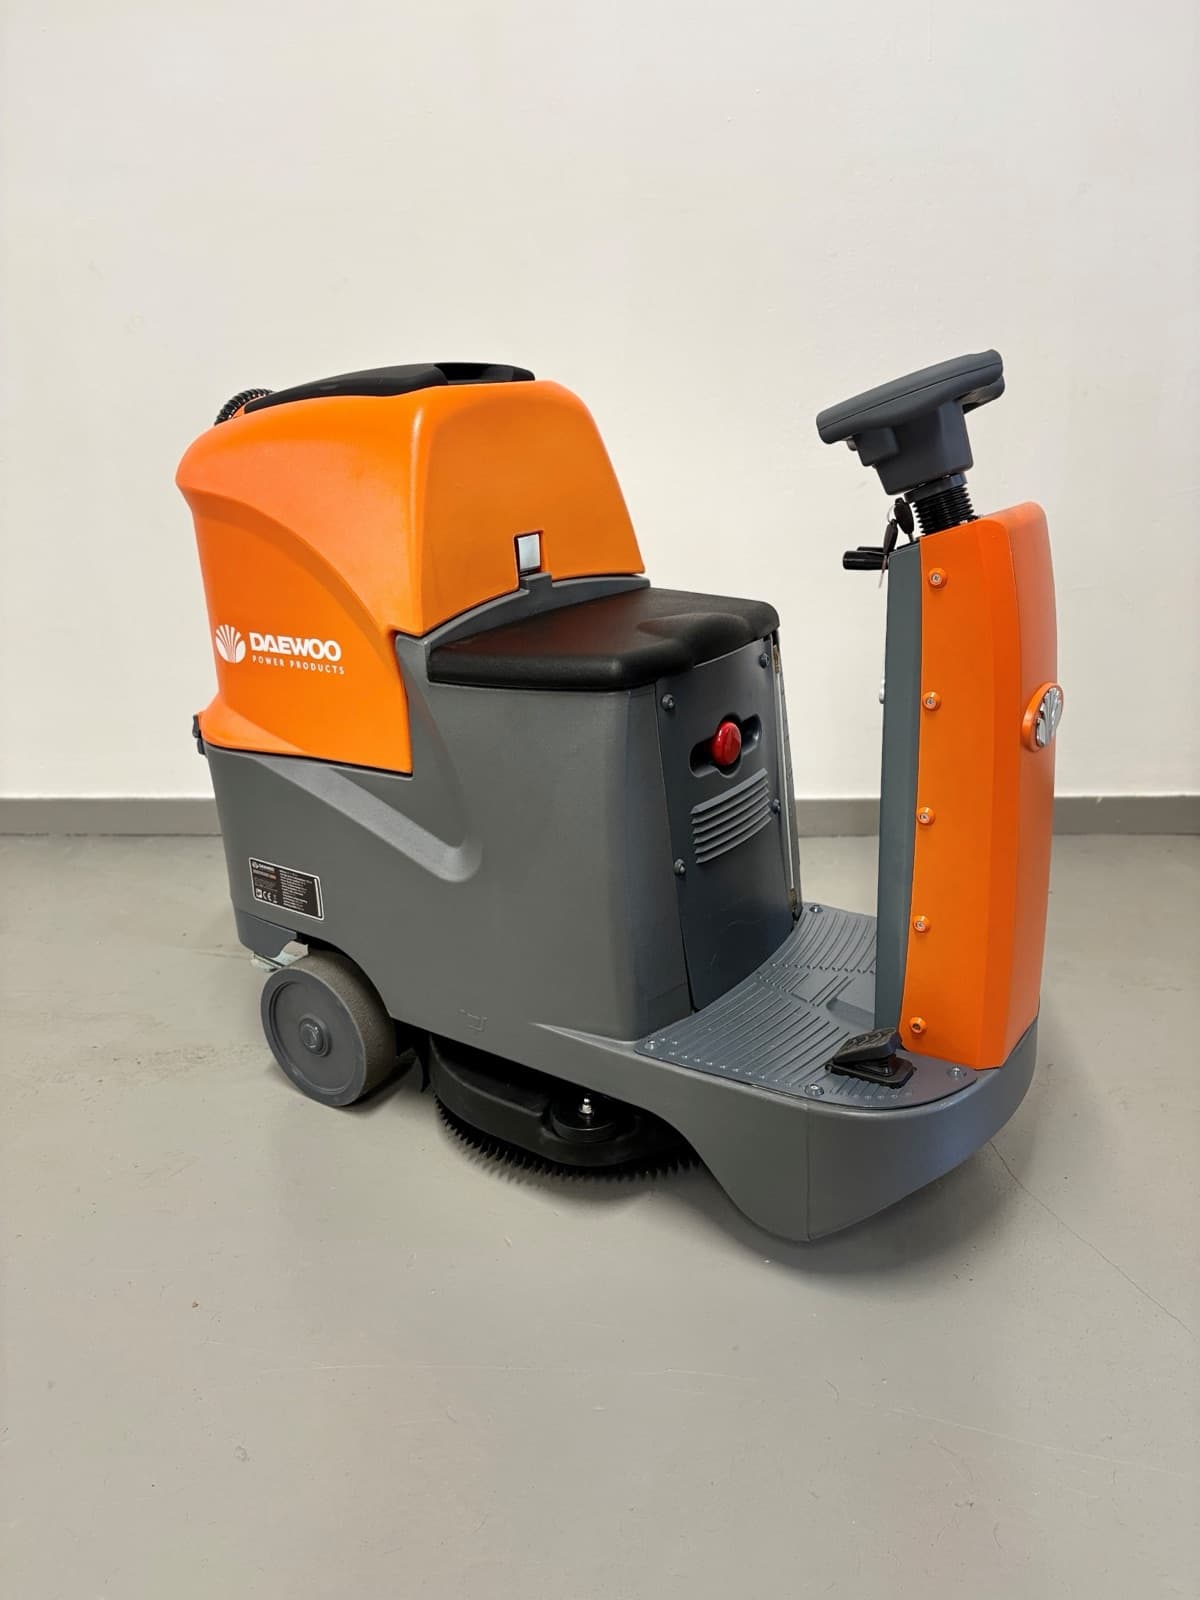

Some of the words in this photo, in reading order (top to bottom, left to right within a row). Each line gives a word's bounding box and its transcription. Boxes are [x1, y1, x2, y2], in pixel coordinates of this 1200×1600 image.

[249, 632, 342, 661] DAEWOO
[252, 655, 284, 667] POWER
[290, 660, 345, 675] PRODUCTS
